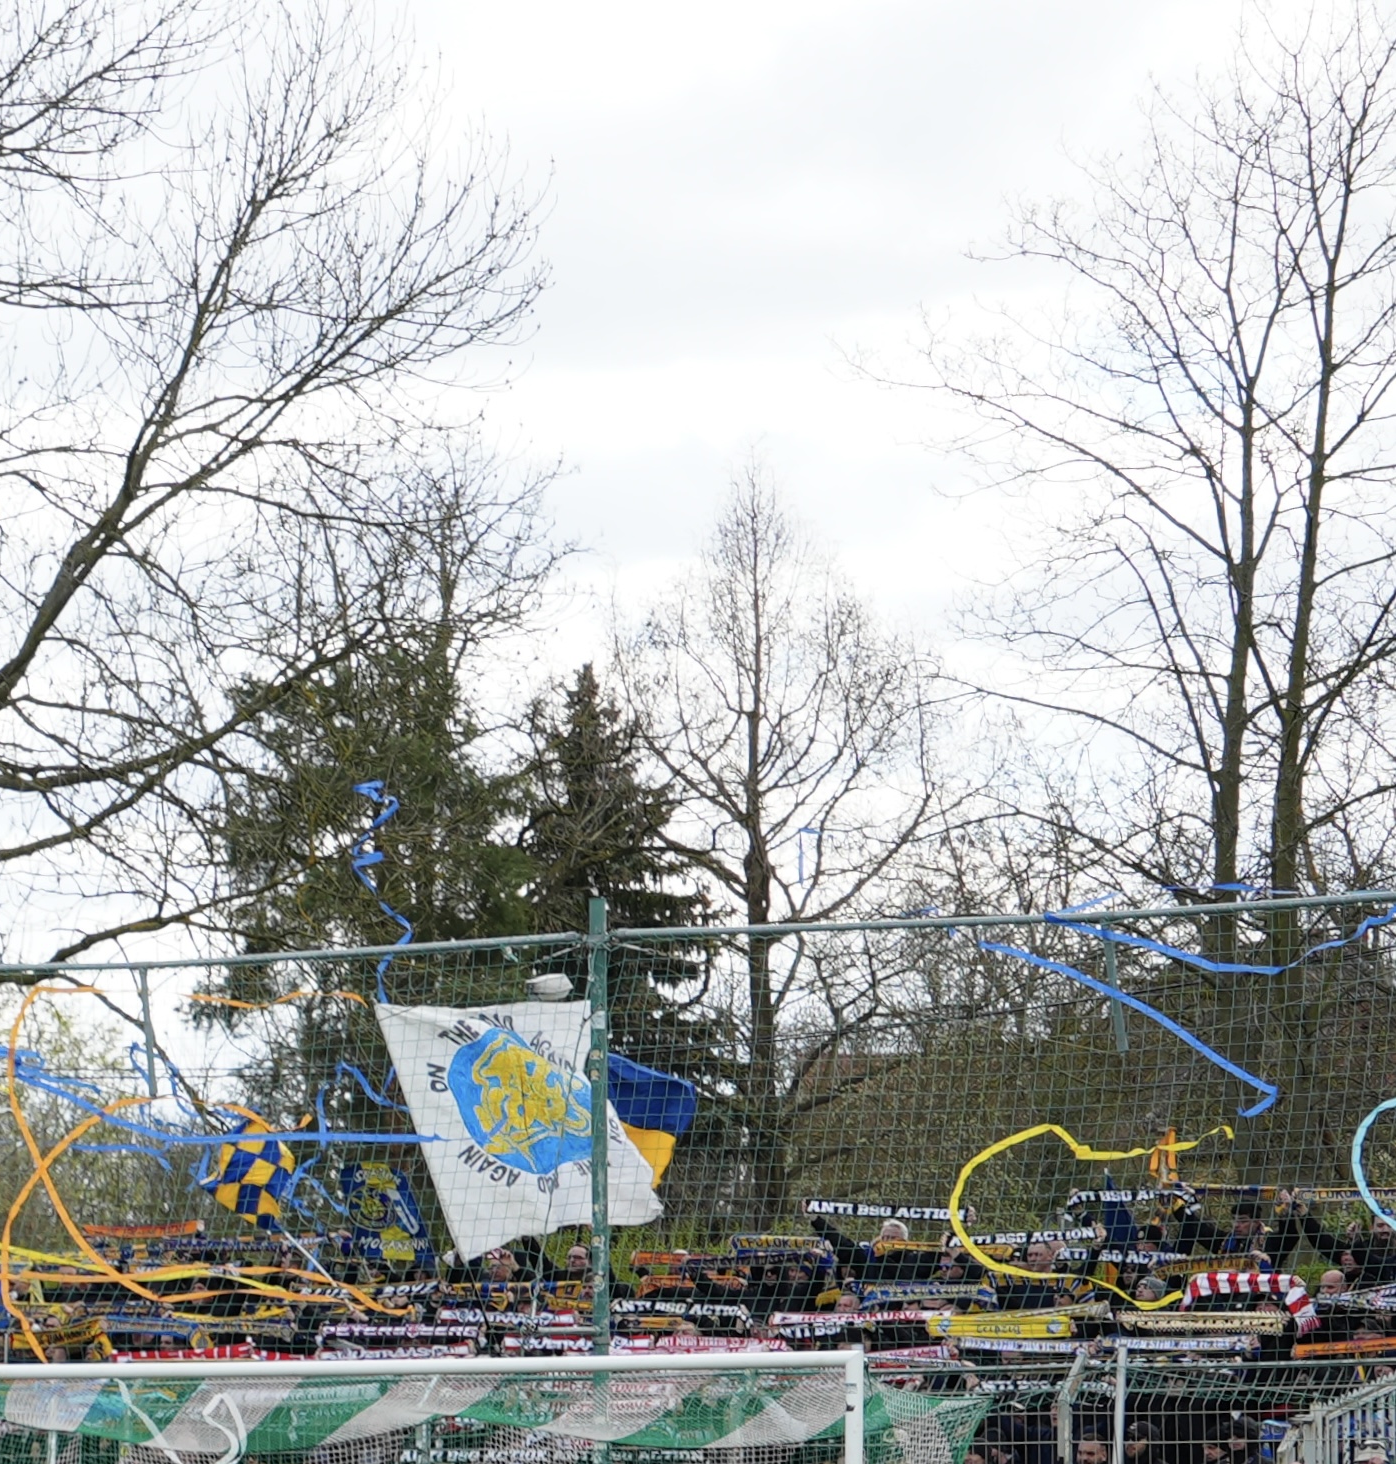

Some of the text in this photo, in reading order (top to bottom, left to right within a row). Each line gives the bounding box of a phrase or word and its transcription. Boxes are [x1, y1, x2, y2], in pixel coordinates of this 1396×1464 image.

[438, 1020, 480, 1045] THE
[458, 1144, 521, 1187] AGAIN
[807, 1200, 853, 1215] ANTI
[857, 1204, 892, 1217] BSG
[995, 1232, 1027, 1244] BSG
[1031, 1227, 1096, 1242] ACTION
[611, 1301, 652, 1313] ANTI
